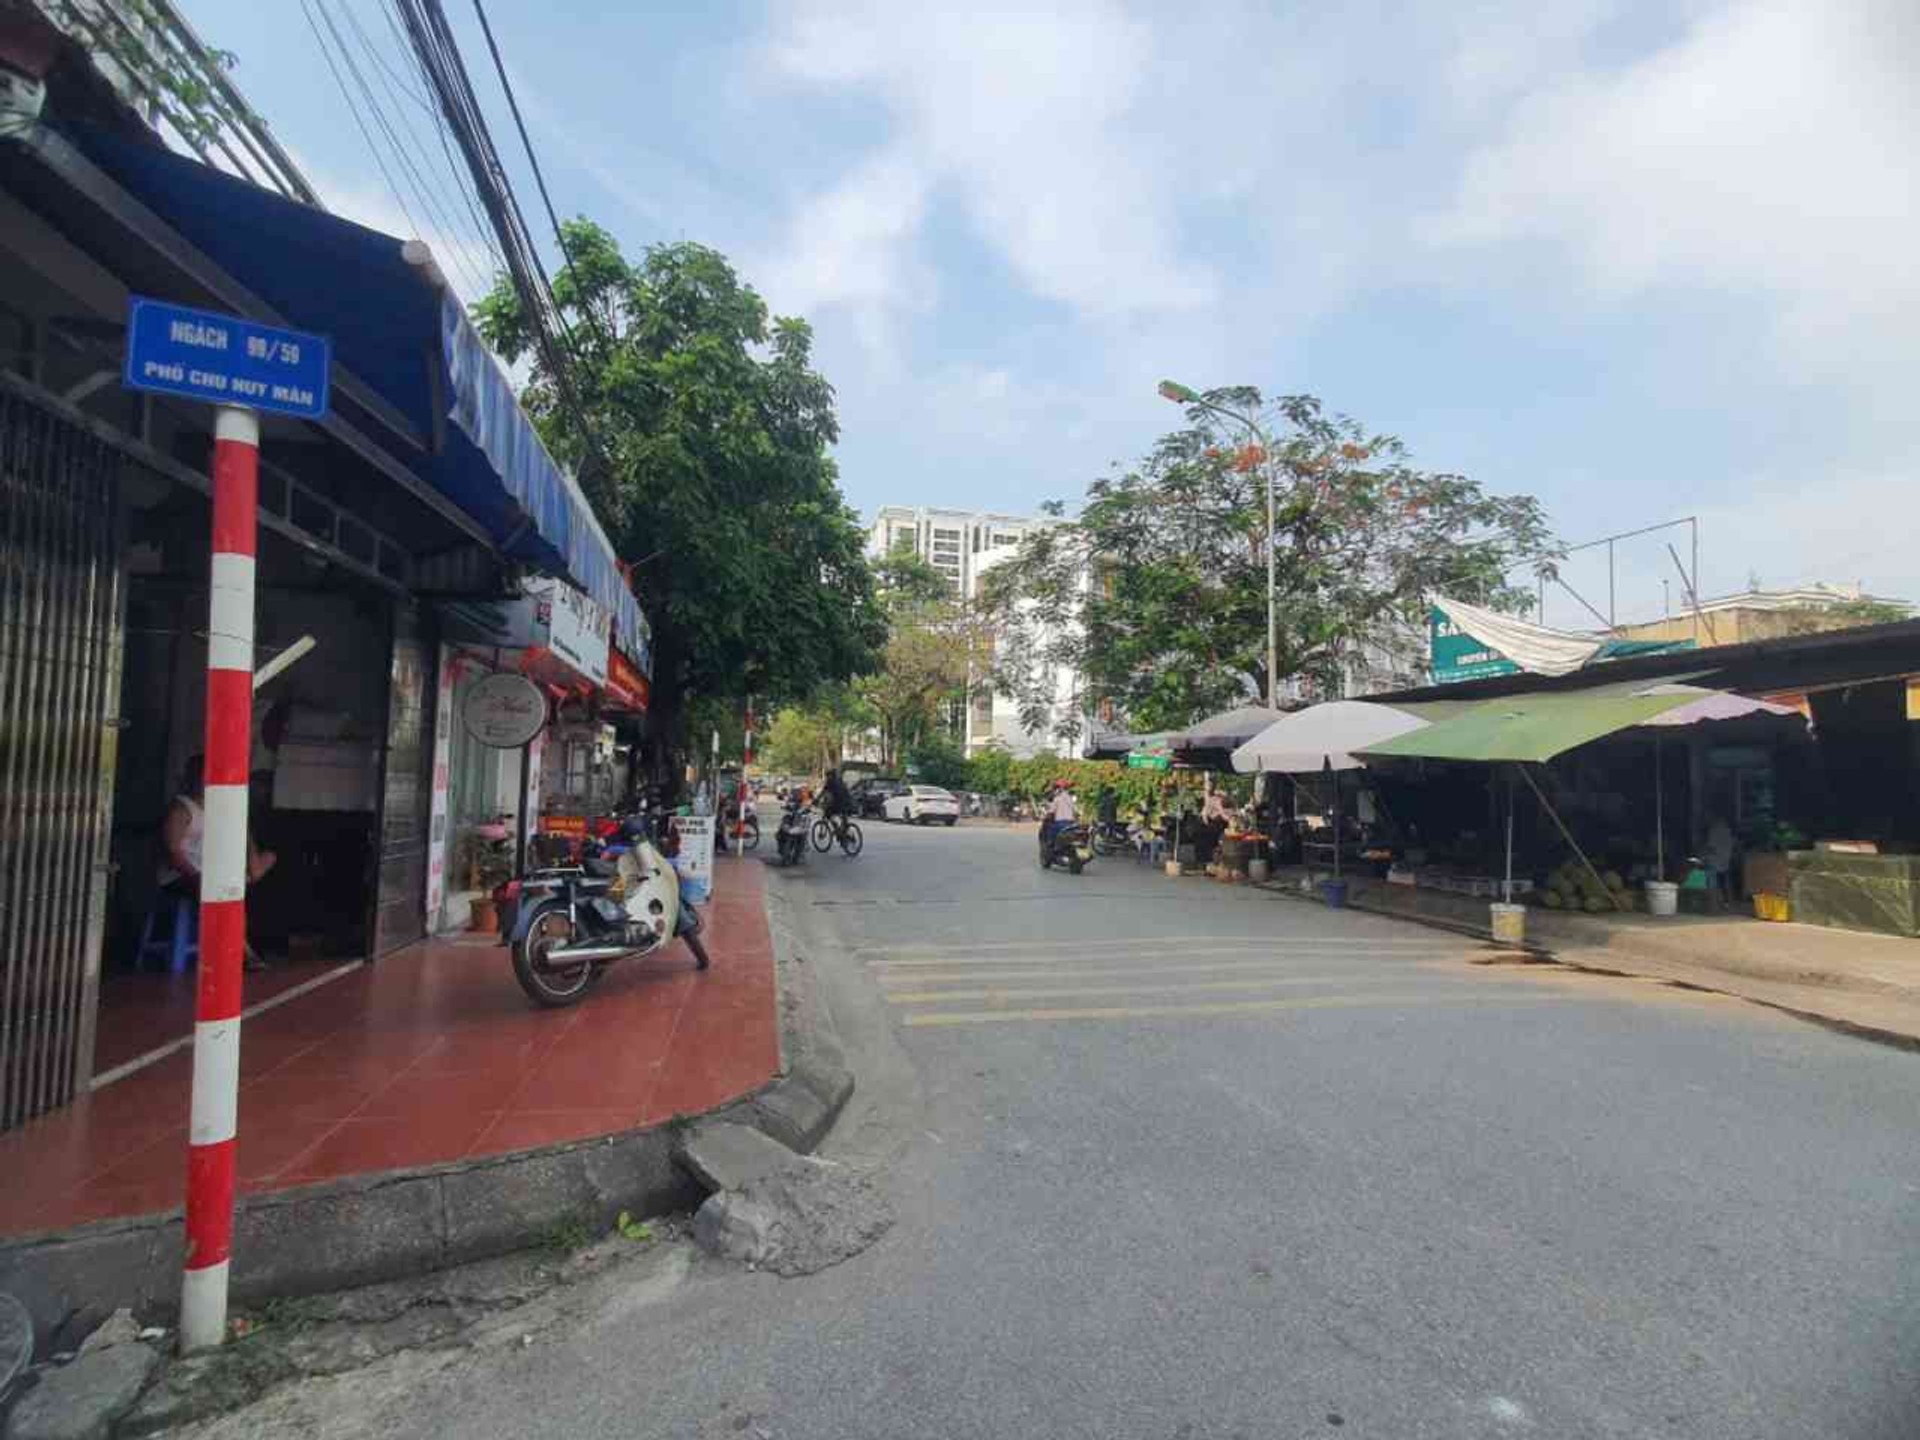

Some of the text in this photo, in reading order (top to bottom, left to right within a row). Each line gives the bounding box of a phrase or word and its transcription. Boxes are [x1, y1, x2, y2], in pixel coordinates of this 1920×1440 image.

[170, 320, 229, 350] NGÁCH
[189, 369, 227, 390] CHU
[231, 377, 268, 397] HUY
